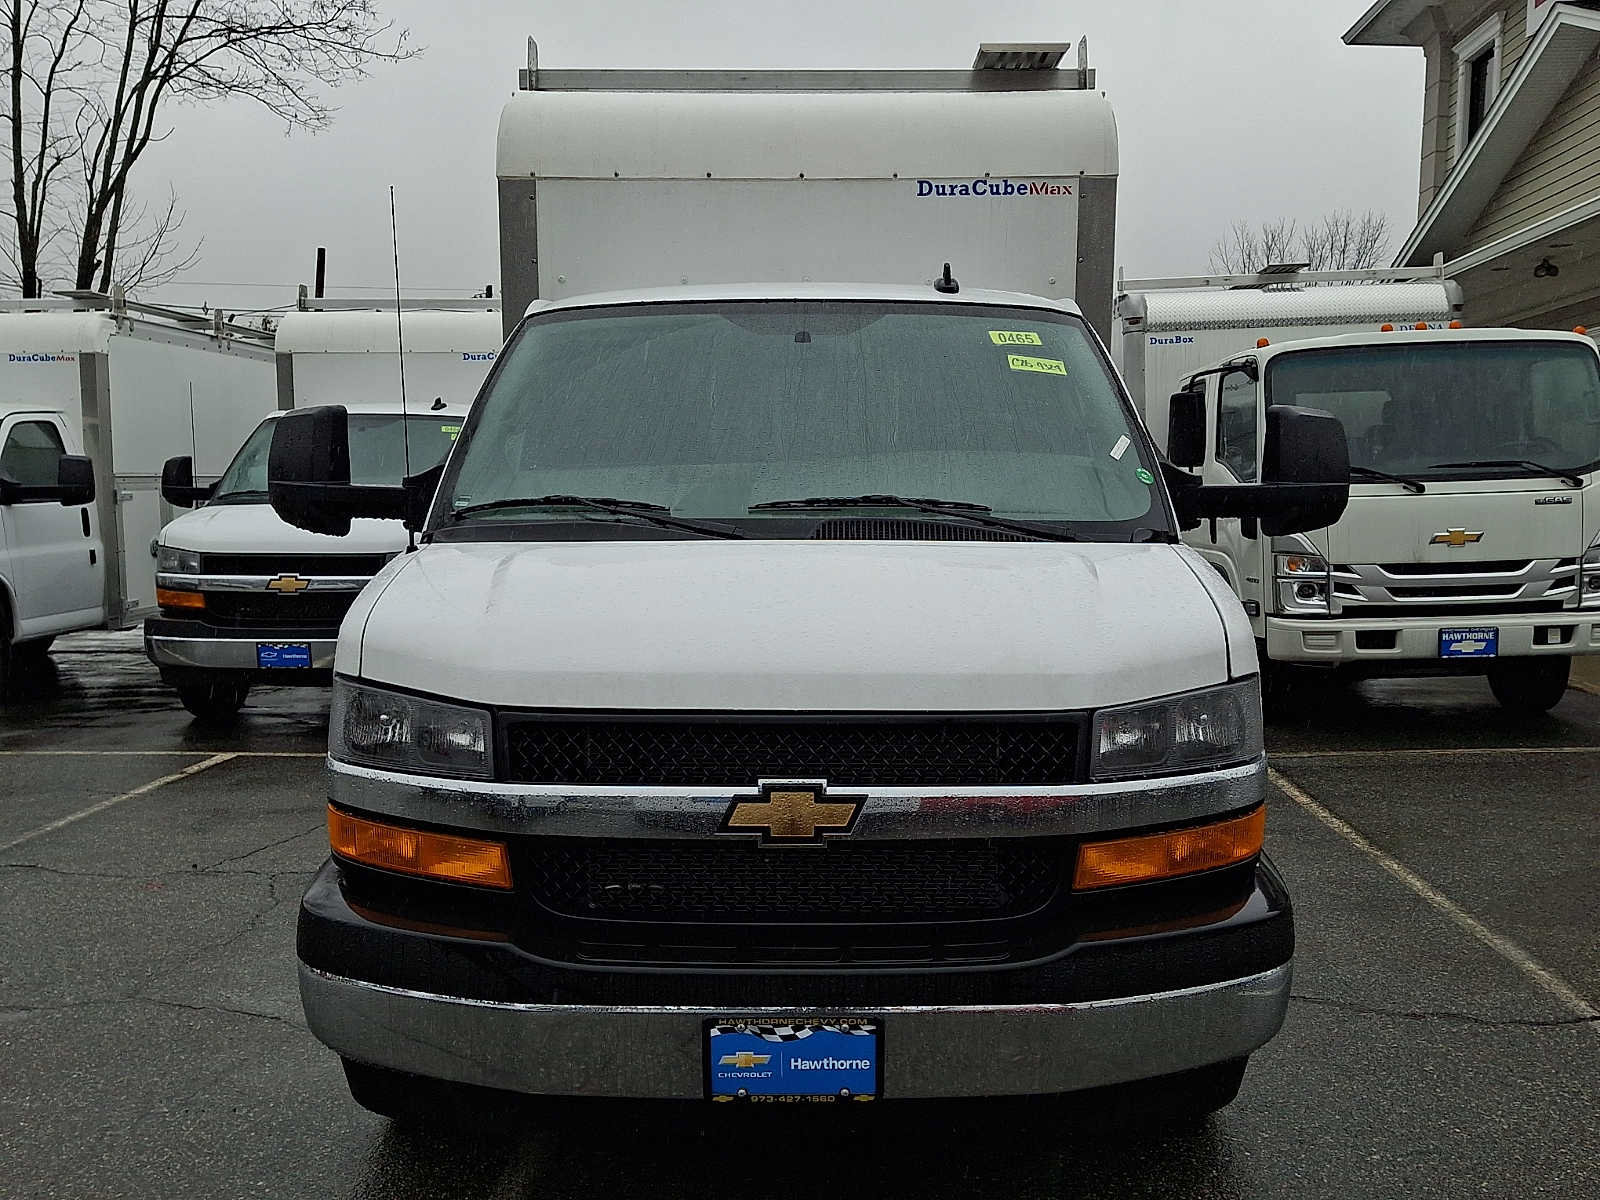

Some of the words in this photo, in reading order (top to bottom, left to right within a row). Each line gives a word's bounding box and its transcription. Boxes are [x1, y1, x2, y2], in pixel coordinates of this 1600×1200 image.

[916, 179, 1073, 197] DuraCubeMax
[998, 332, 1035, 343] 0465
[1149, 335, 1194, 345] DuraBox
[8, 353, 76, 362] DuraCubeMax
[1441, 631, 1496, 641] HAWTHORNE
[718, 1018, 869, 1026] HAWTHORNECHEVY.COM
[789, 1056, 871, 1071] Hawthorne
[717, 1071, 773, 1079] CHEVROLET
